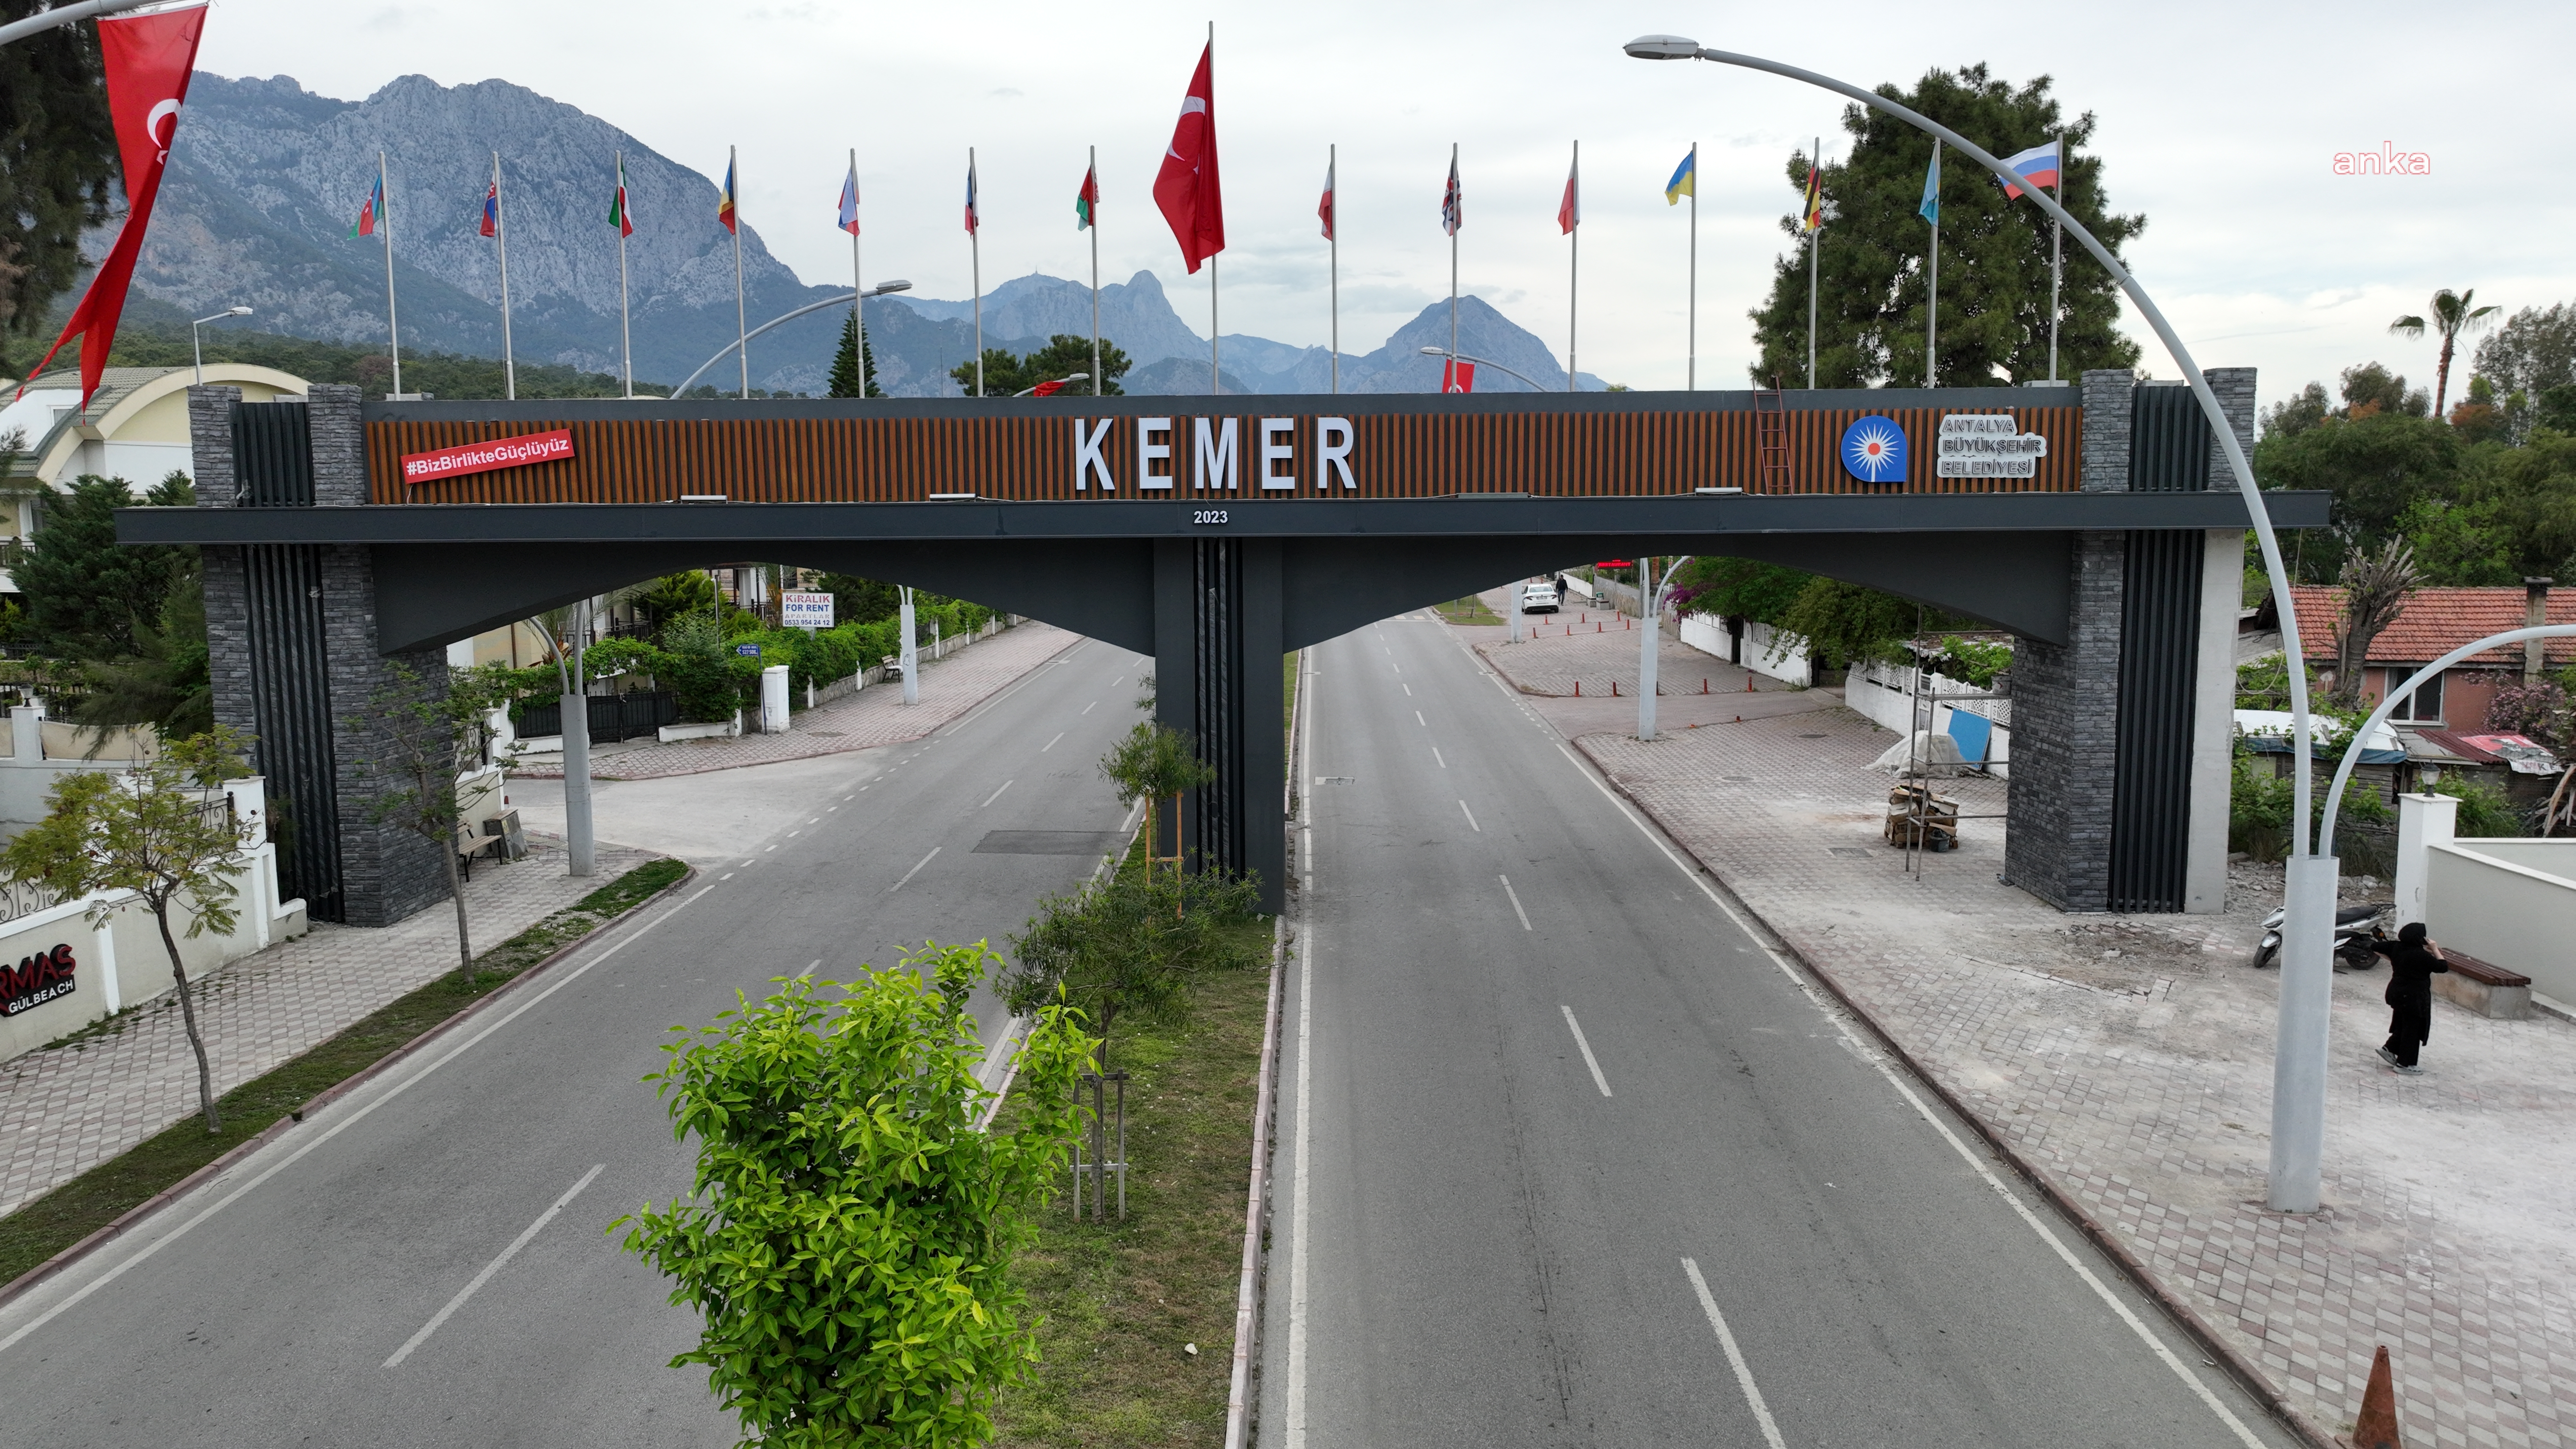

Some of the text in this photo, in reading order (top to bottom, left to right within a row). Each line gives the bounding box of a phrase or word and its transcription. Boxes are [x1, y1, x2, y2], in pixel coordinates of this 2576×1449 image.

[1942, 419, 2014, 432] ANTALYA
[1075, 418, 1357, 490] KEMER
[1943, 437, 2041, 456] BÜYÜKŞEHİR
[406, 438, 569, 475] #BizBirlikteGüçlüyüz
[1941, 459, 2032, 474] BELEDİYESİ
[1194, 511, 1228, 523] 2023
